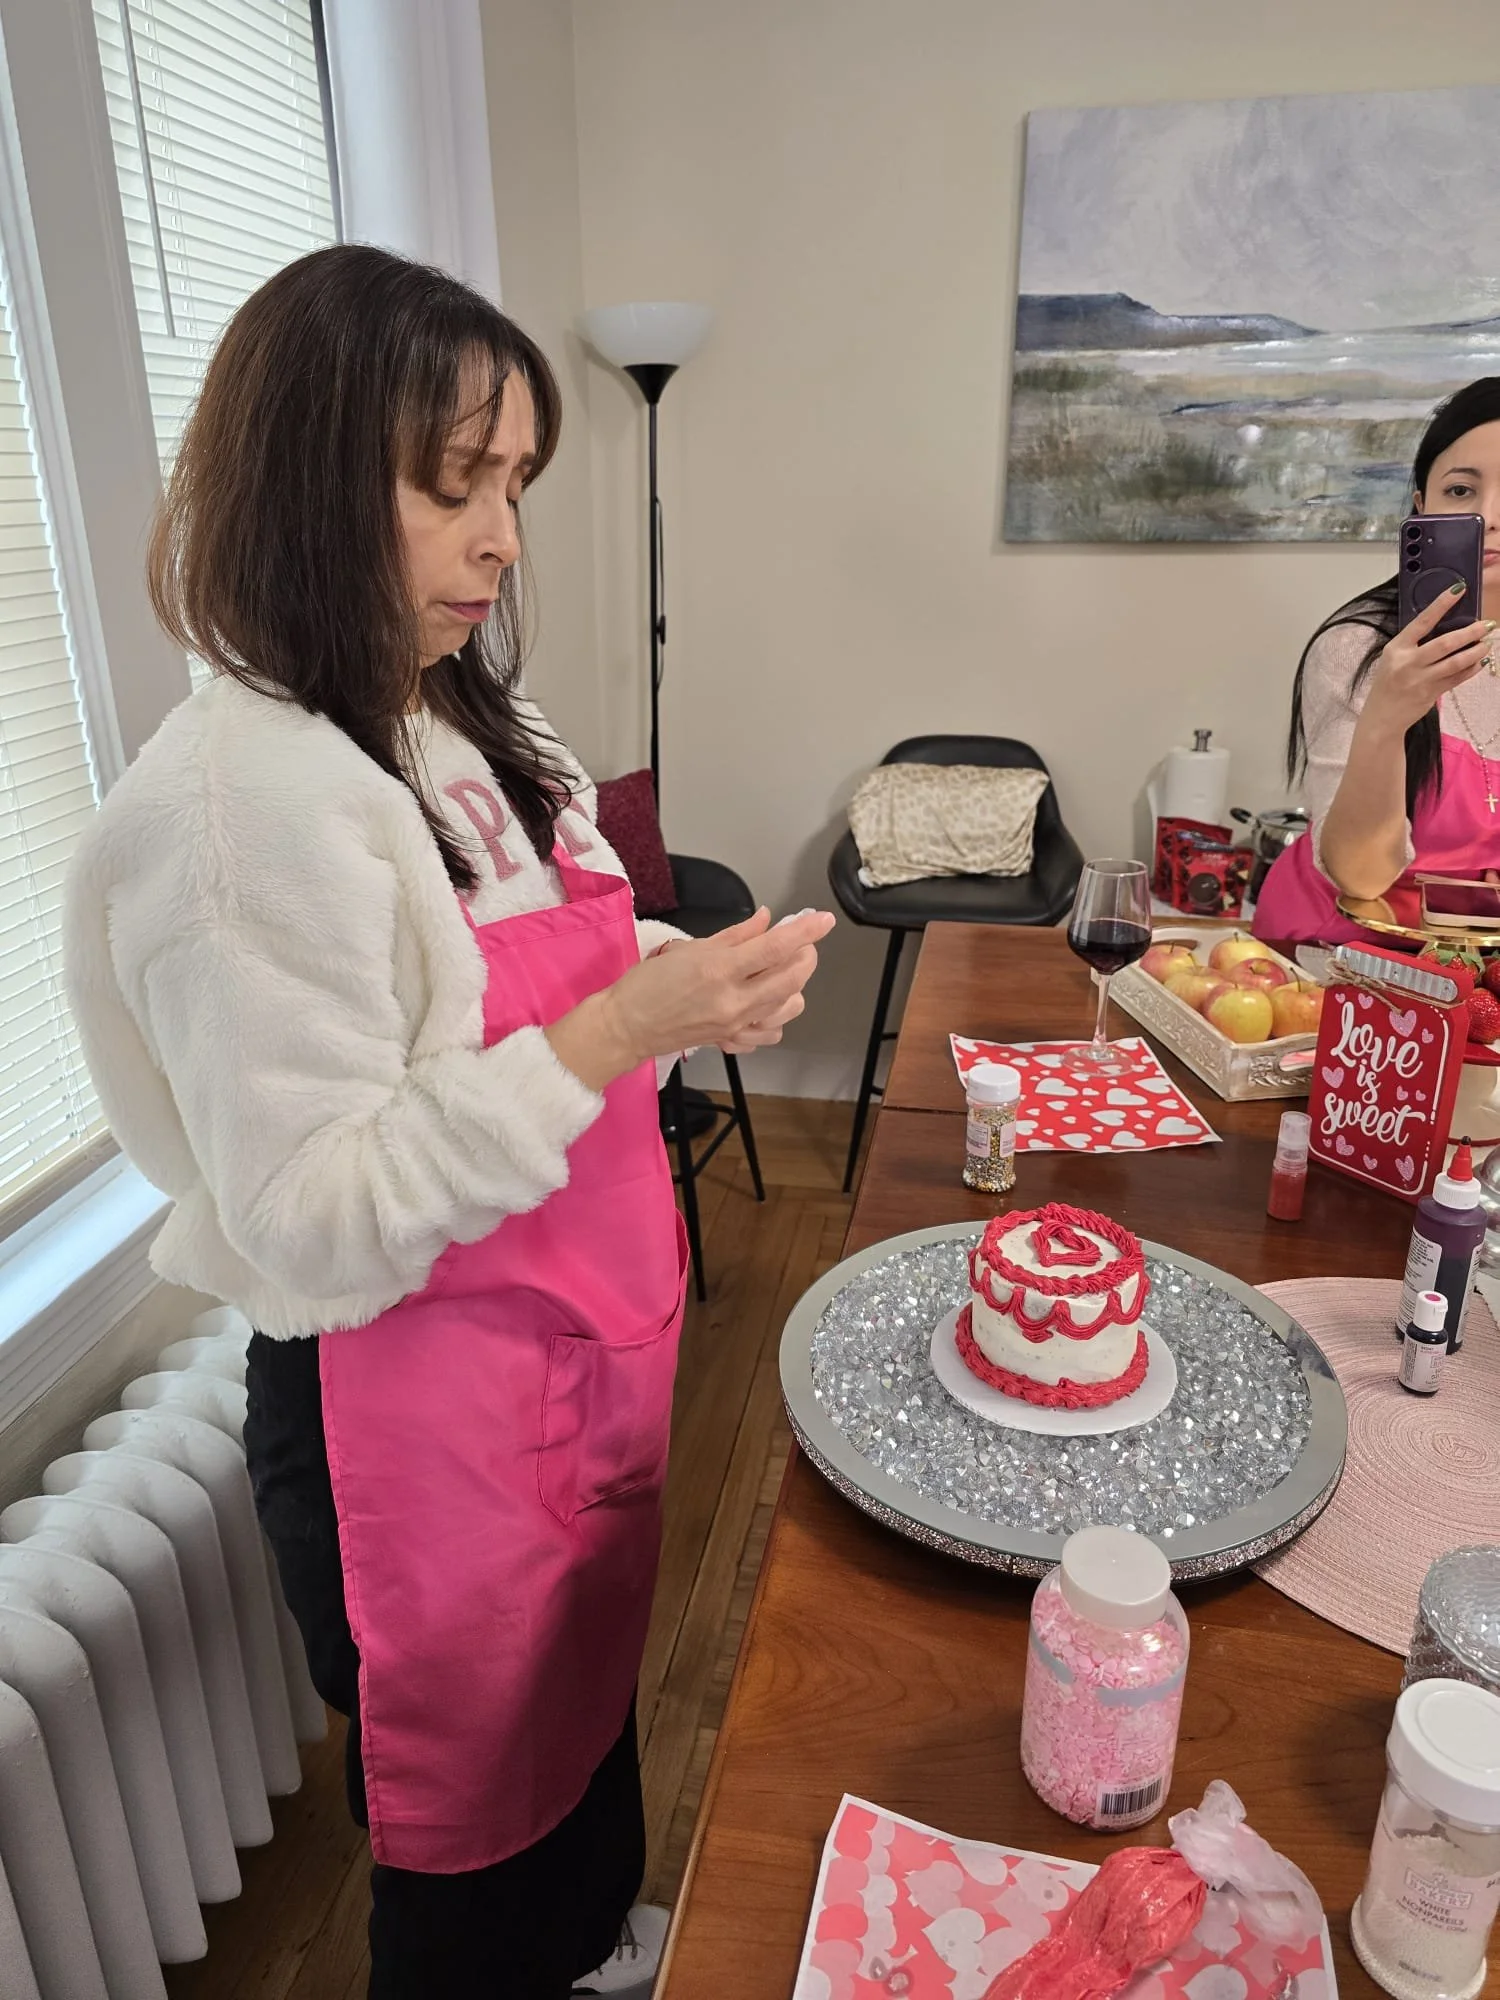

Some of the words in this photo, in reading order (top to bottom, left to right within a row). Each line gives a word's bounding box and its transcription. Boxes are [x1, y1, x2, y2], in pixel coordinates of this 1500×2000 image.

[1330, 1001, 1423, 1078] Love
[1356, 1059, 1381, 1105] is
[1418, 1898, 1451, 1917] WHITE
